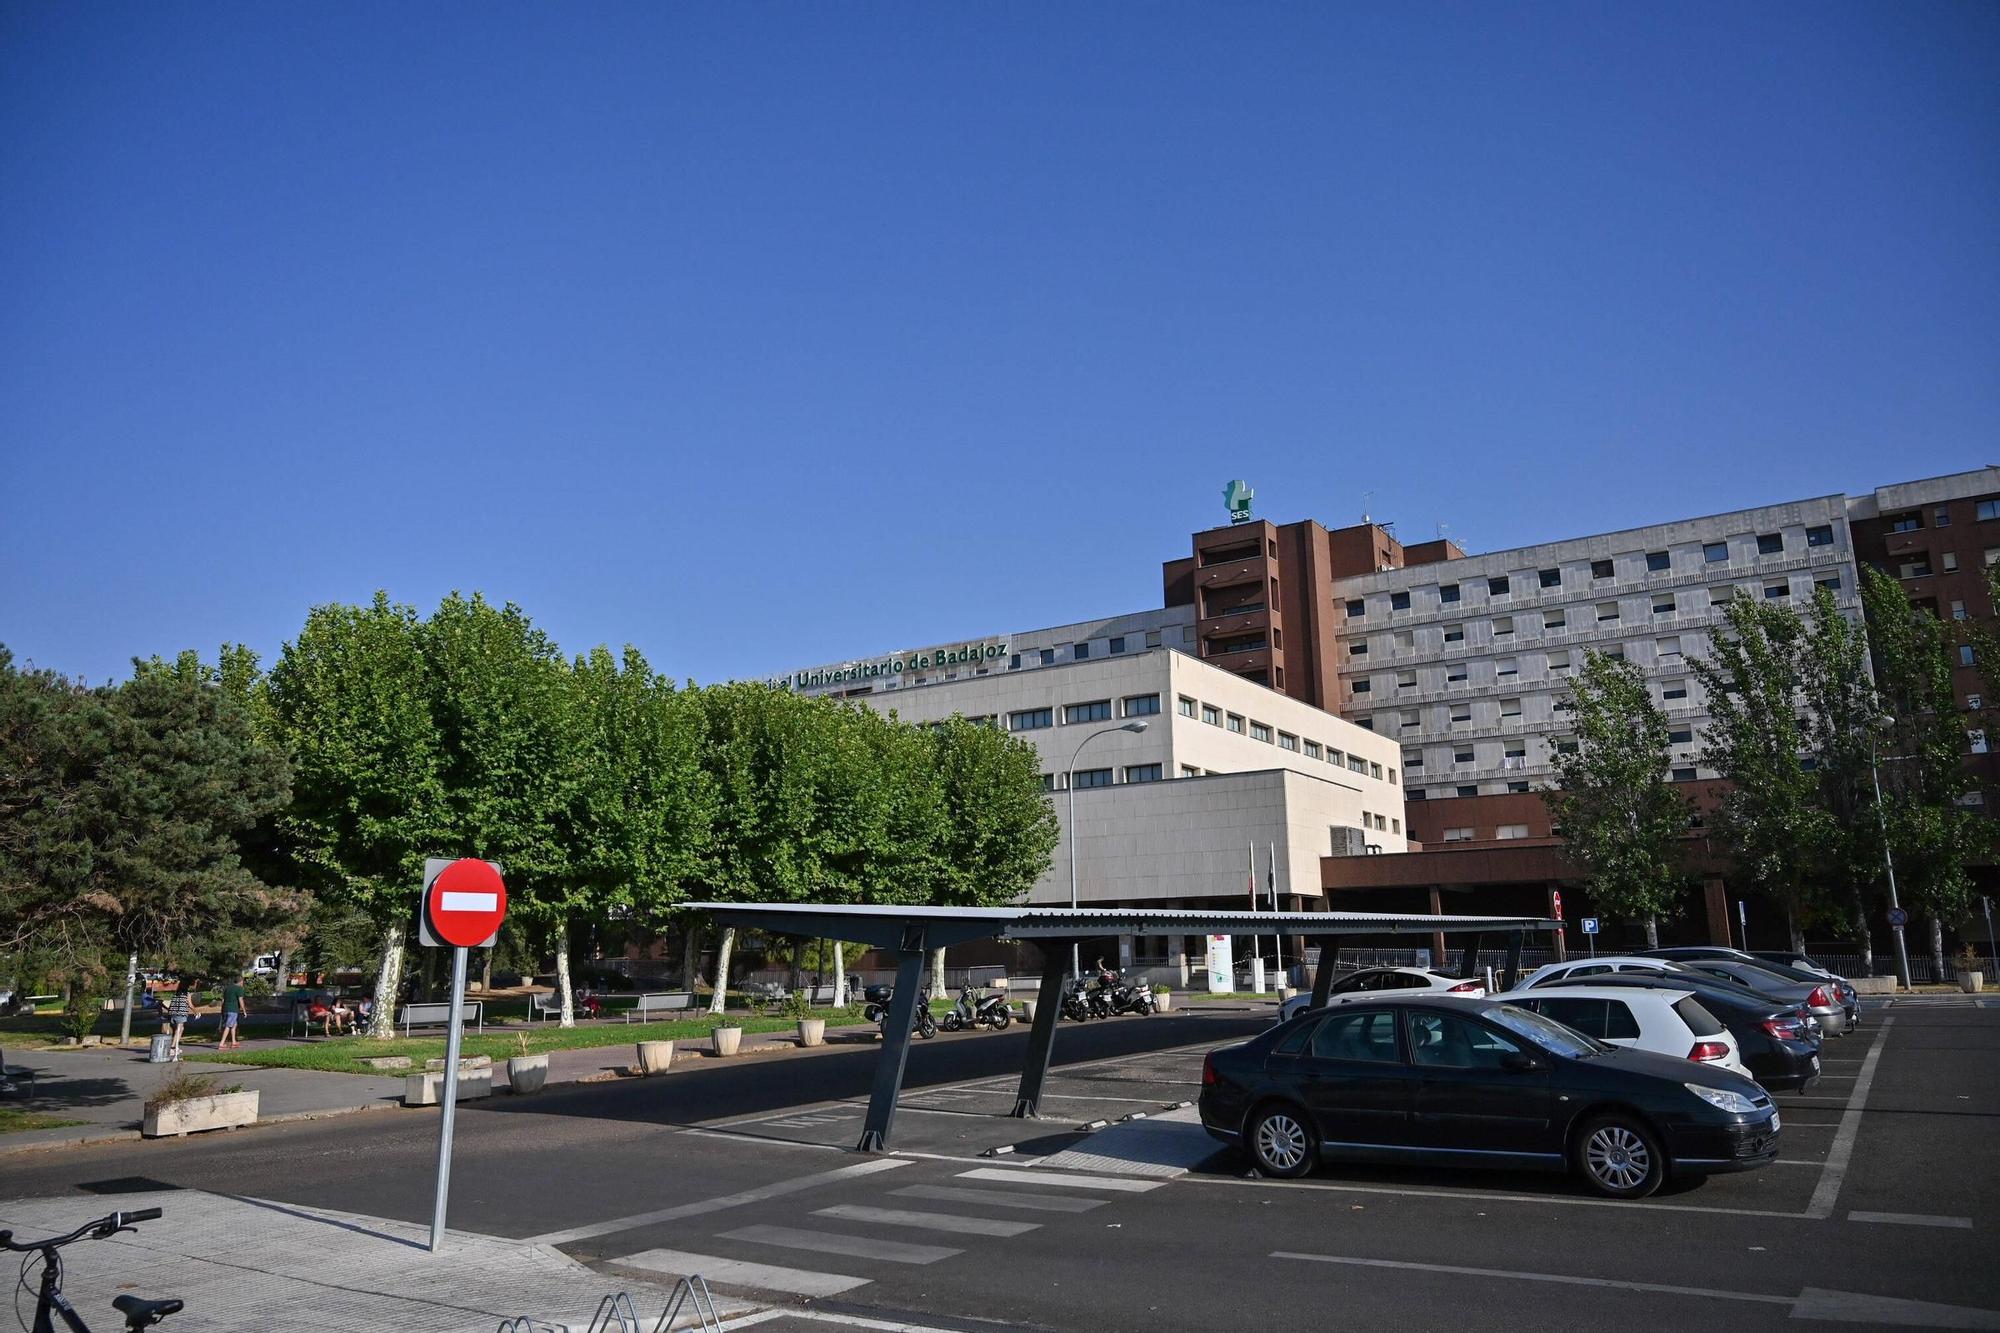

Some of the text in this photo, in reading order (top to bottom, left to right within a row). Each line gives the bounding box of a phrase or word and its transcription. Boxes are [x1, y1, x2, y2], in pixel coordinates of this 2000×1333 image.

[1231, 510, 1249, 520] SES
[798, 658, 904, 688] Universitario
[909, 653, 929, 670] de
[935, 643, 1007, 666] Badajoz
[1584, 920, 1595, 932] P
